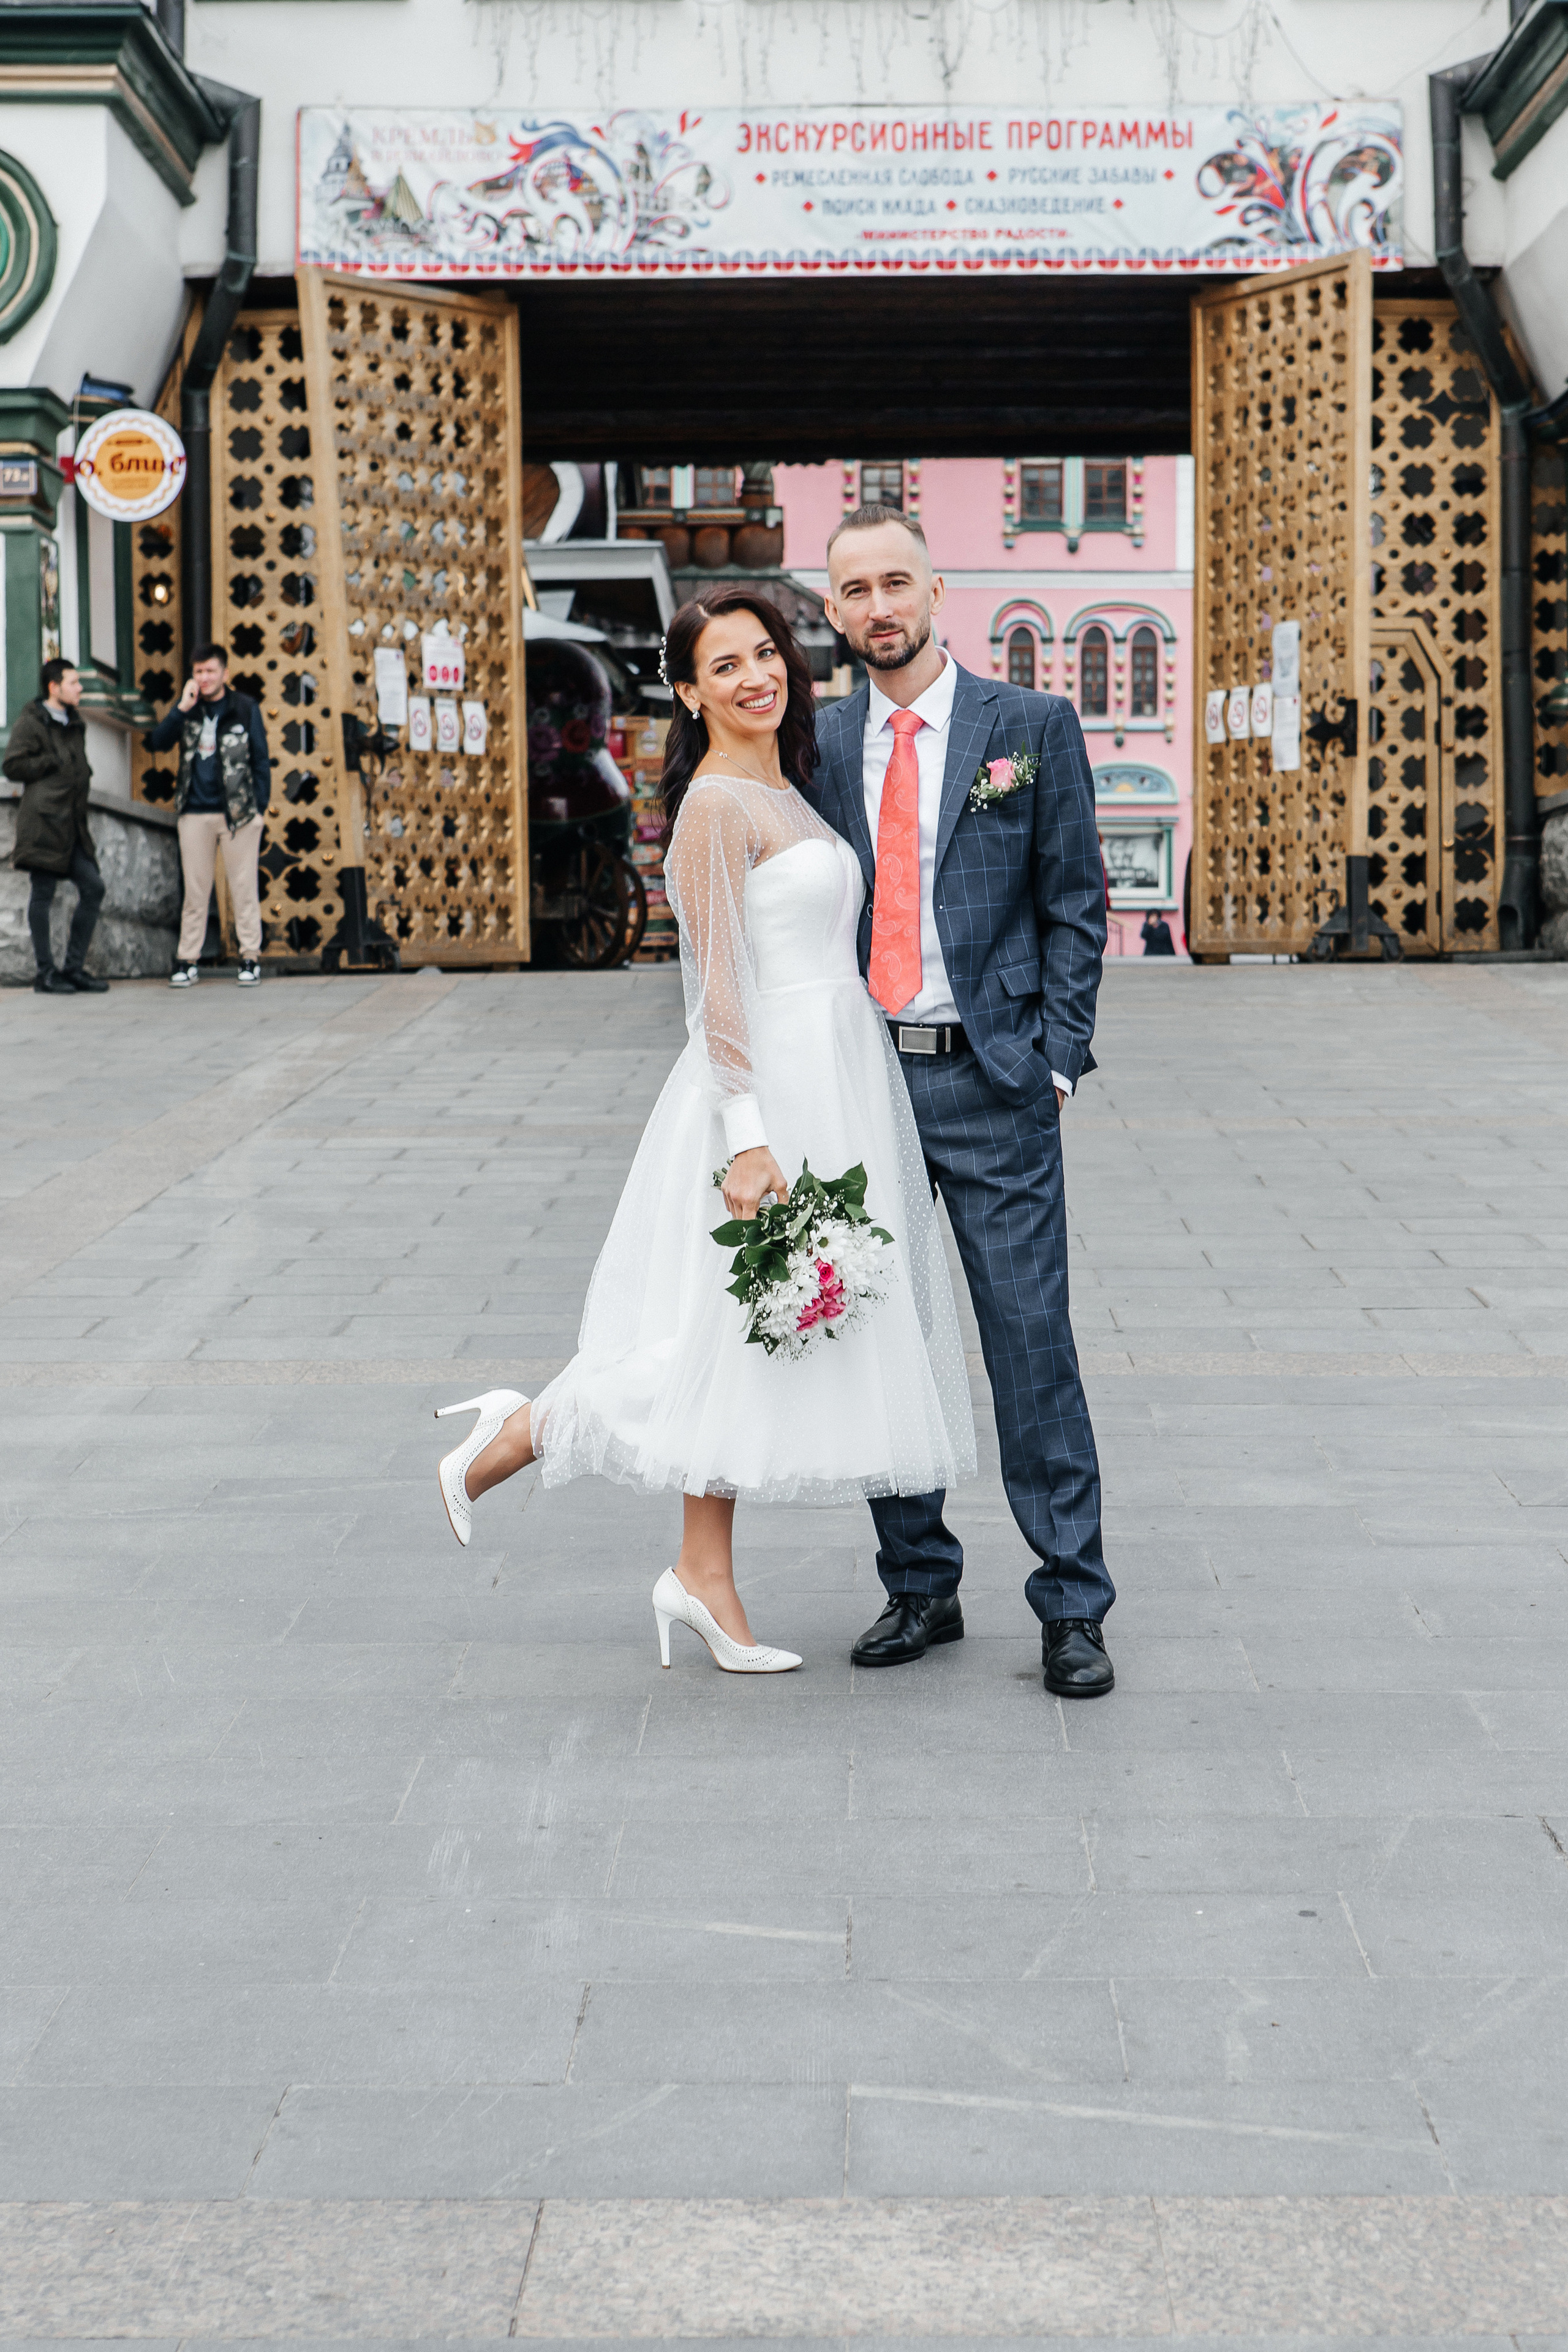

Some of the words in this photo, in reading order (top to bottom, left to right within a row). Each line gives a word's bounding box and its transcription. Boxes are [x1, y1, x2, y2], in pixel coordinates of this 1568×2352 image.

[737, 121, 993, 153] ЭКСКУРСИОННЫЕ
[1008, 119, 1193, 150] ПРОГРАММЫ
[772, 168, 892, 186] РЕМЕСЛЕННАЯ
[899, 167, 975, 186] СЛОБОДА
[1008, 167, 1080, 184] РУССКИЕ
[1088, 167, 1157, 184] ЗАБАВЫ
[822, 198, 876, 216] ПОИСК
[882, 198, 936, 216] КЛАДА
[964, 196, 1105, 214] СКАЗКОВЕДЕНИЕ
